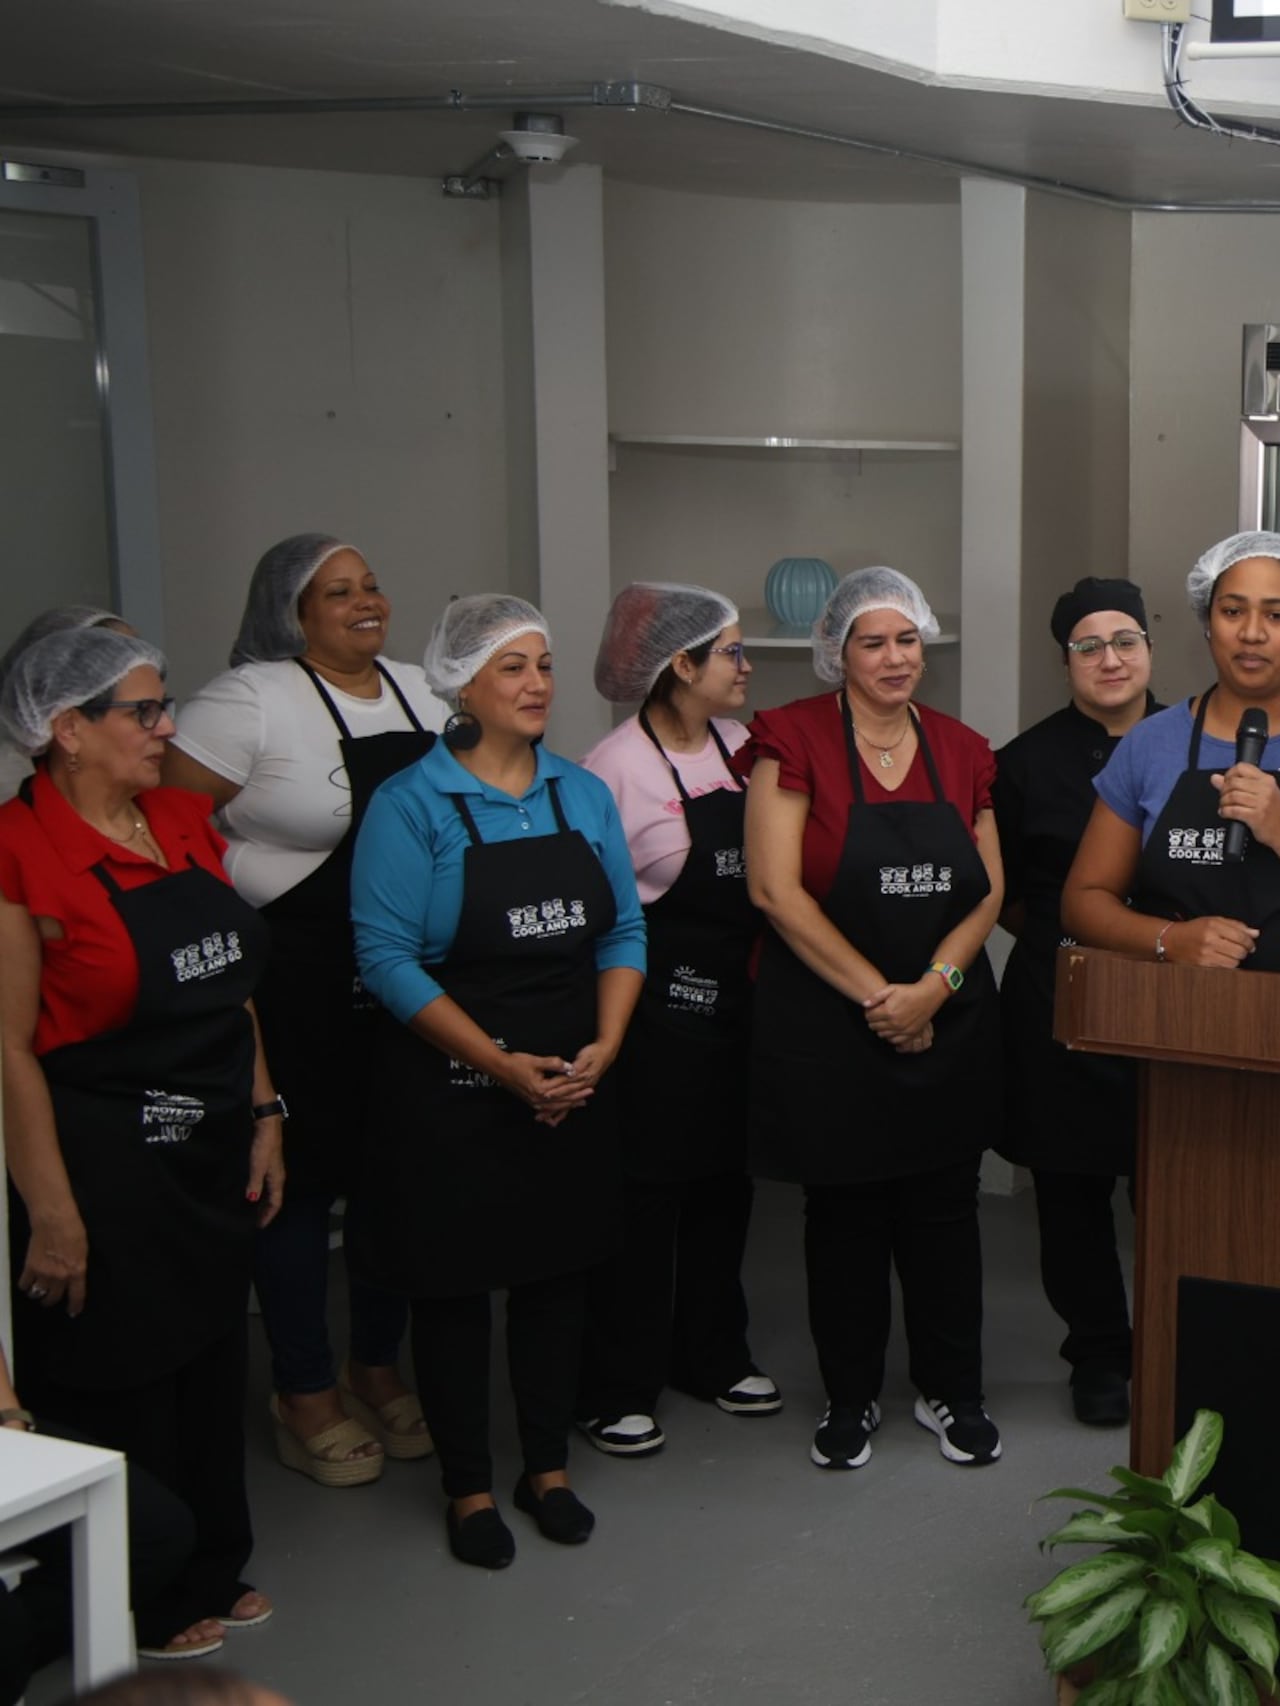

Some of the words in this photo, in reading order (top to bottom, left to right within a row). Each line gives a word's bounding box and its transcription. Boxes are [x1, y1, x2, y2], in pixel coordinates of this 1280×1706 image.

[1168, 848, 1201, 859] COOK
[881, 885, 911, 894] COOK
[912, 884, 934, 893] AND
[935, 882, 952, 892] GO
[512, 925, 545, 938] COOK
[546, 919, 569, 932] AND
[570, 916, 587, 927] GO
[177, 963, 206, 982] COOK
[207, 956, 228, 972] AND
[227, 950, 243, 963] GO
